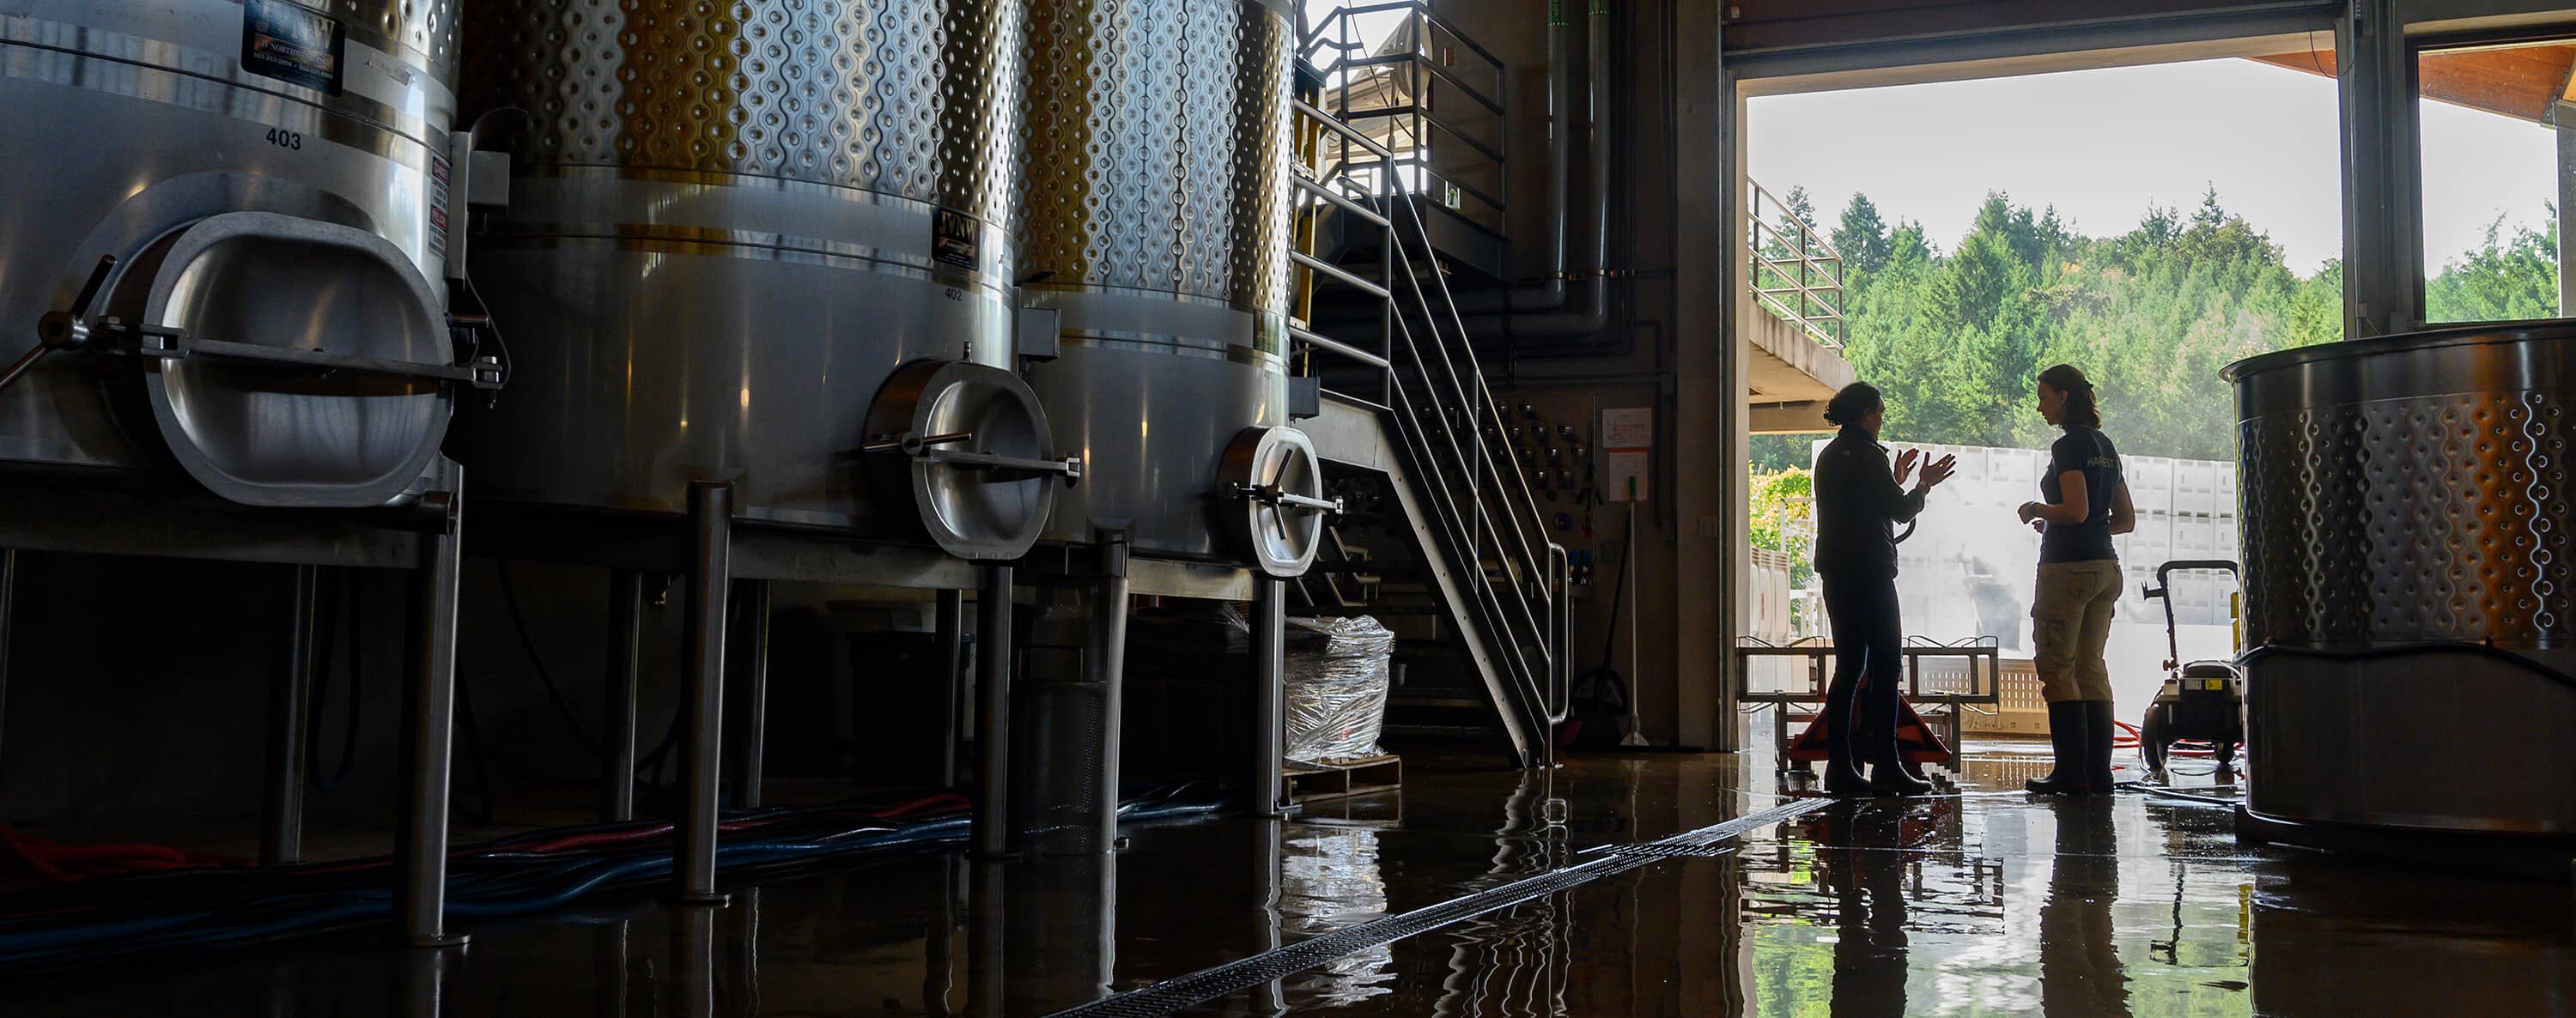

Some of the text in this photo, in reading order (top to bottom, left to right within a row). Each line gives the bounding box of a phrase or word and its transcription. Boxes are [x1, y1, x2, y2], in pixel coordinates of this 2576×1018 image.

[255, 1, 336, 48] JNW
[266, 127, 301, 151] 403
[939, 210, 977, 241] JVNW
[945, 287, 963, 302] 402
